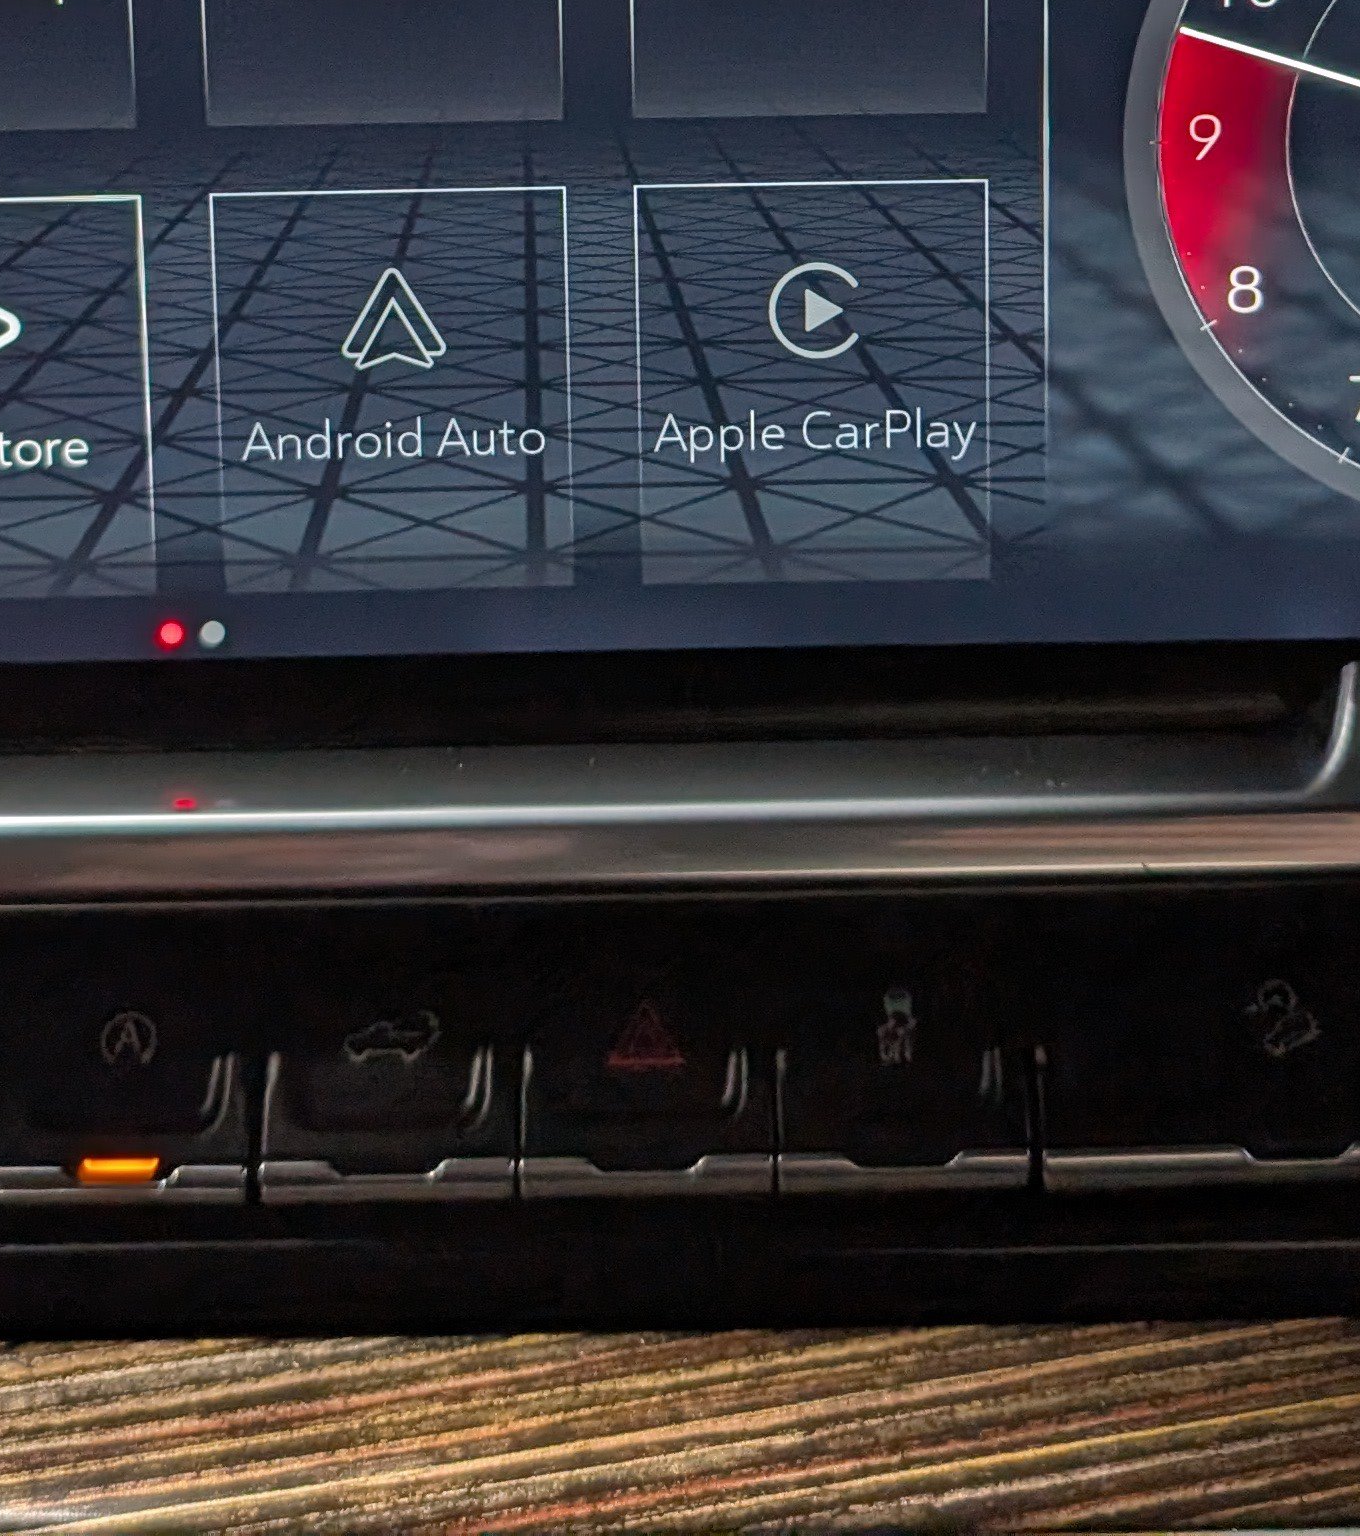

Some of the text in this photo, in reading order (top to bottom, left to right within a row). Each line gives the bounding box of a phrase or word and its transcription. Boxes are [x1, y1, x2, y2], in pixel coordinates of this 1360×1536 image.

[1190, 114, 1221, 160] 9
[1228, 266, 1262, 313] 8
[242, 416, 545, 460] Android Auto
[654, 407, 976, 462] Apple CarPlay
